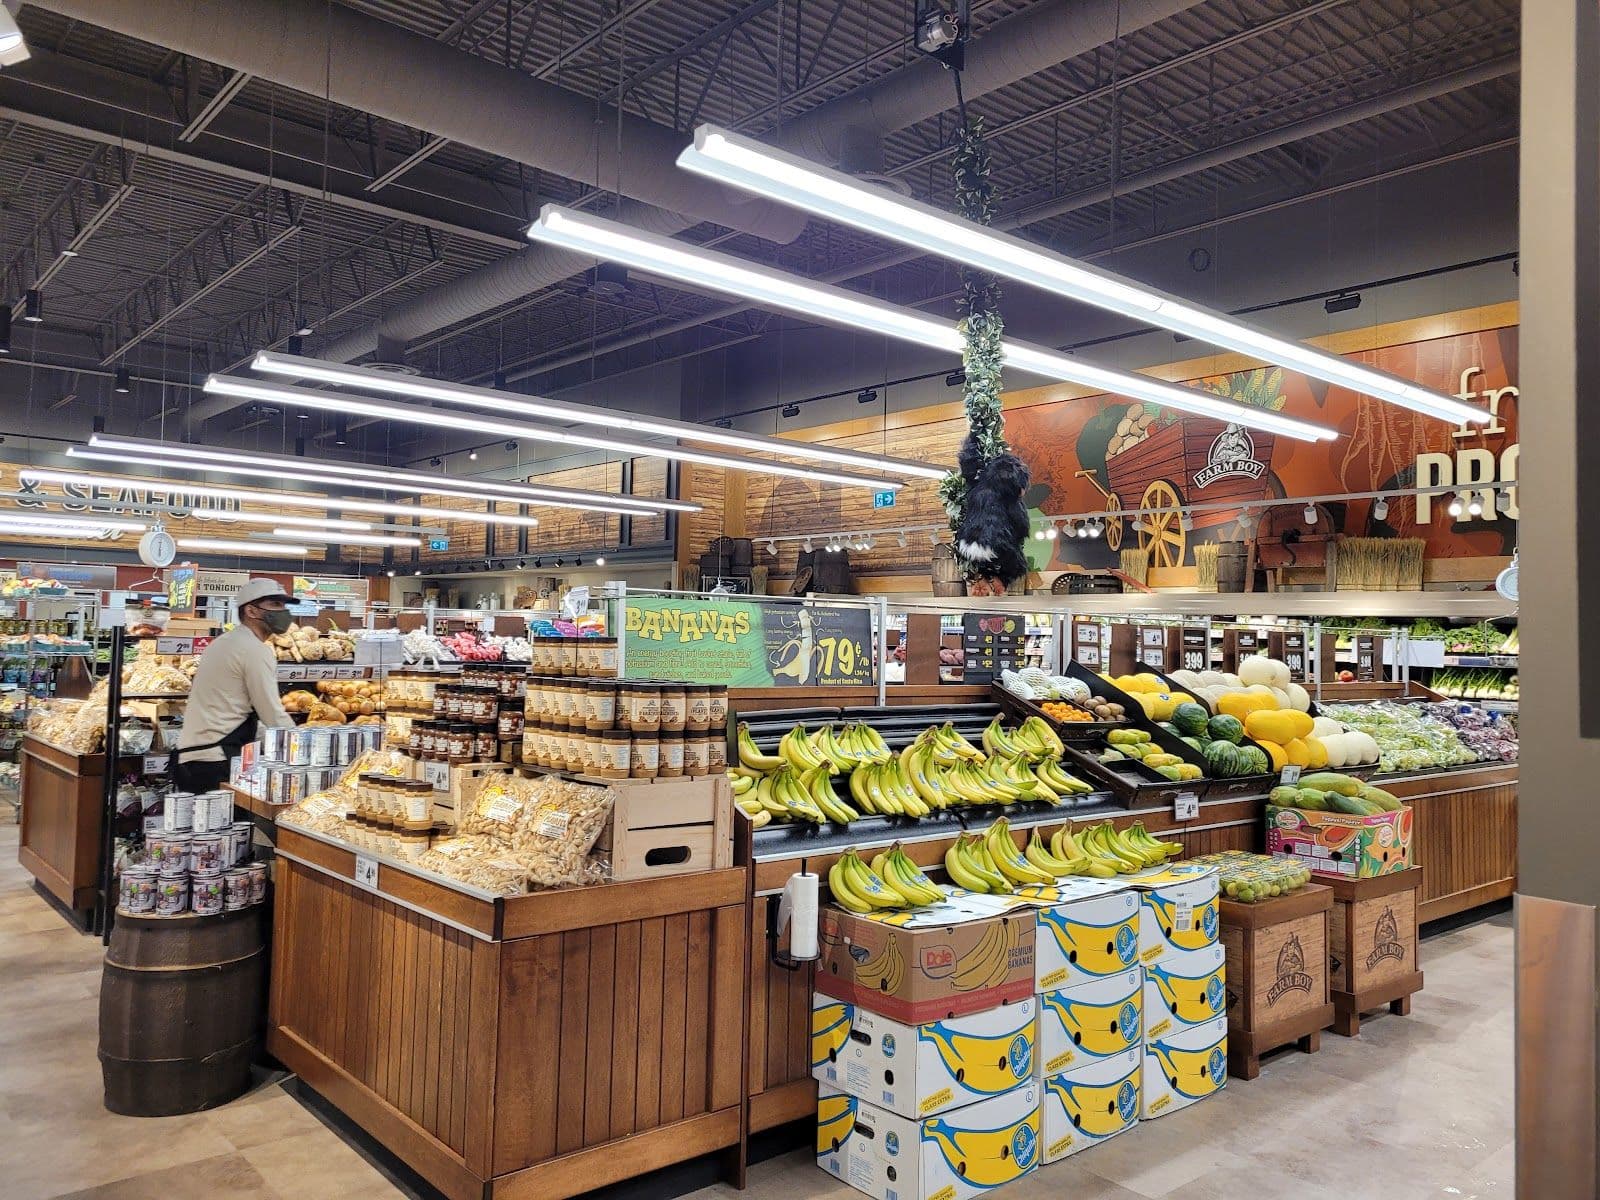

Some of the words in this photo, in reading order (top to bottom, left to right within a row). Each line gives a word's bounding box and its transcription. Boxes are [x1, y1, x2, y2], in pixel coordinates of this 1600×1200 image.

[1197, 461, 1233, 484] FARM
[1237, 460, 1262, 476] BOY
[625, 607, 751, 644] BANANAS
[926, 950, 953, 965] Dole
[1007, 945, 1033, 959] PREMIUM
[1007, 955, 1033, 970] BANANAS
